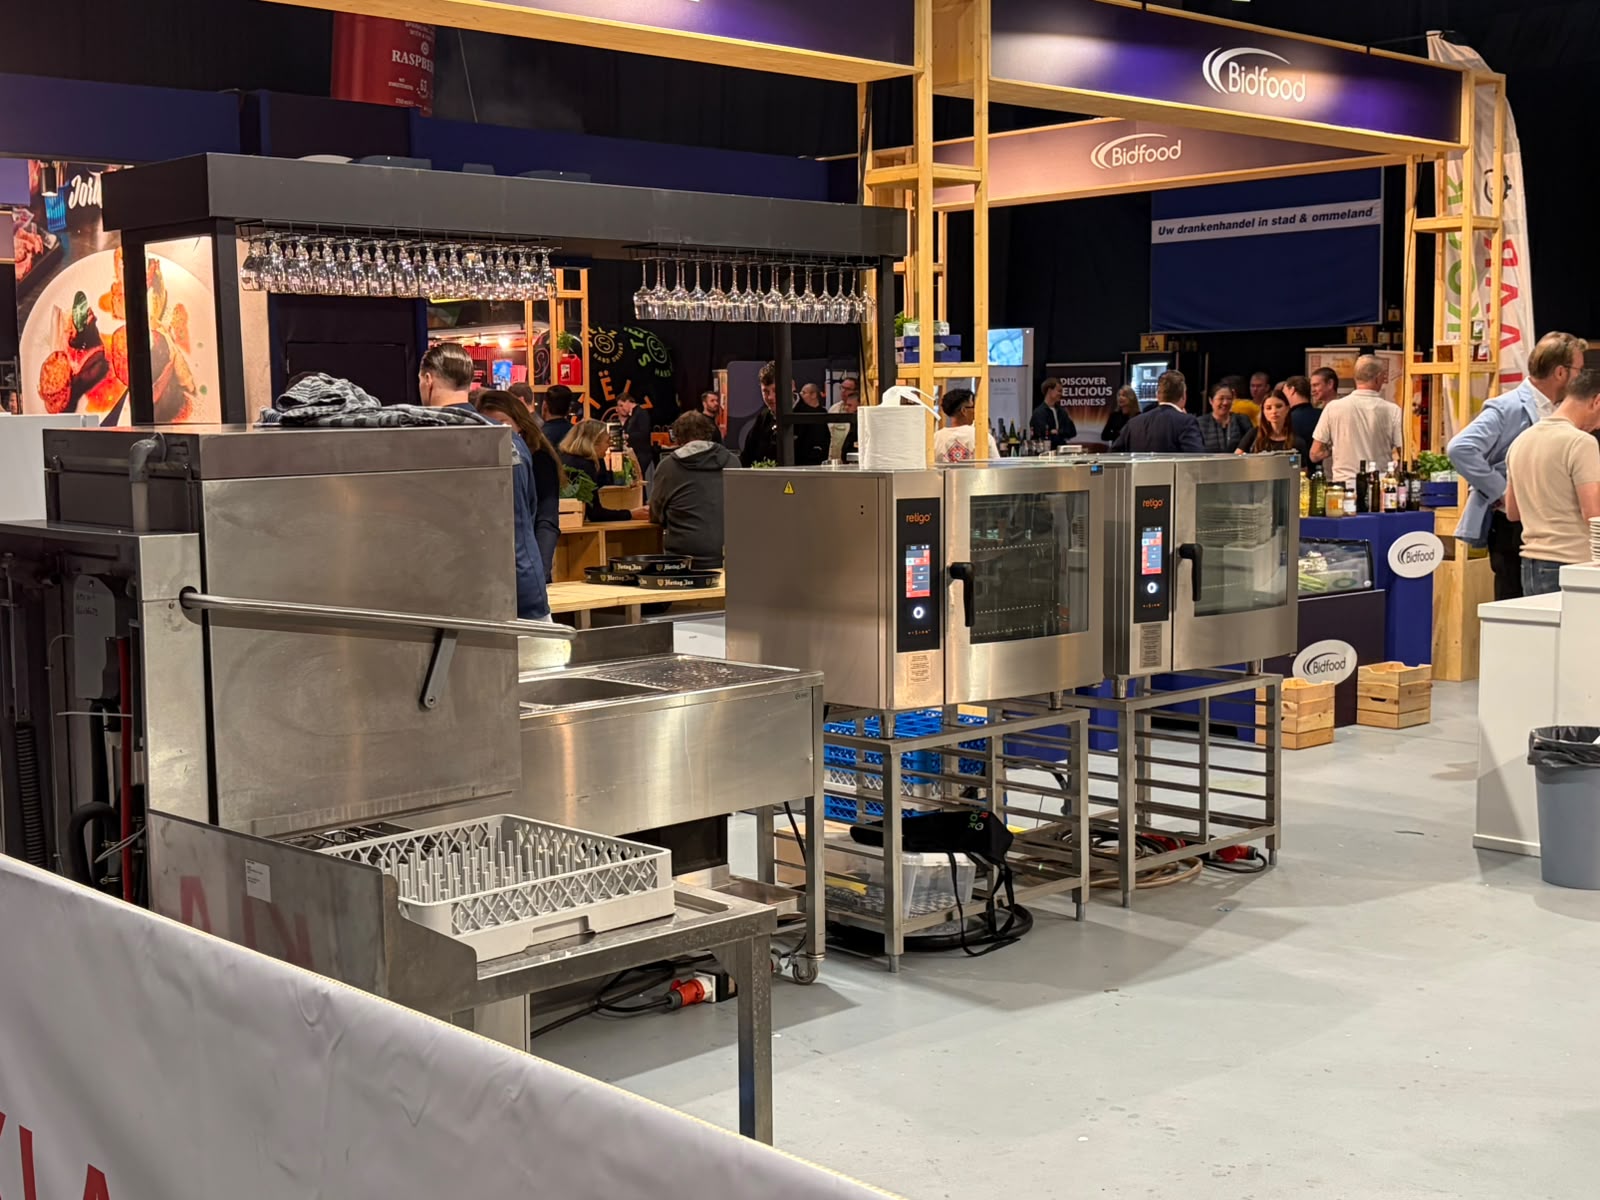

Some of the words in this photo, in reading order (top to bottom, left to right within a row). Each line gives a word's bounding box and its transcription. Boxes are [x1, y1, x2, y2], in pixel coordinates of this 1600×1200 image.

[1228, 61, 1306, 102] Bidfood
[1112, 139, 1181, 167] Bidfood
[1158, 225, 1175, 237] Uw
[1177, 218, 1255, 235] drankenhandel
[1257, 217, 1268, 228] in
[1271, 214, 1296, 226] stad
[1299, 213, 1308, 223] &
[1311, 206, 1373, 223] ommeland
[1060, 377, 1107, 387] DISCOVER
[1061, 386, 1113, 397] ELICIOUS
[1060, 398, 1106, 408] DARKNESS
[1143, 499, 1163, 510] retigo
[906, 512, 930, 525] retigo
[1406, 548, 1435, 564] Bidfood
[1313, 656, 1347, 675] Bidfood
